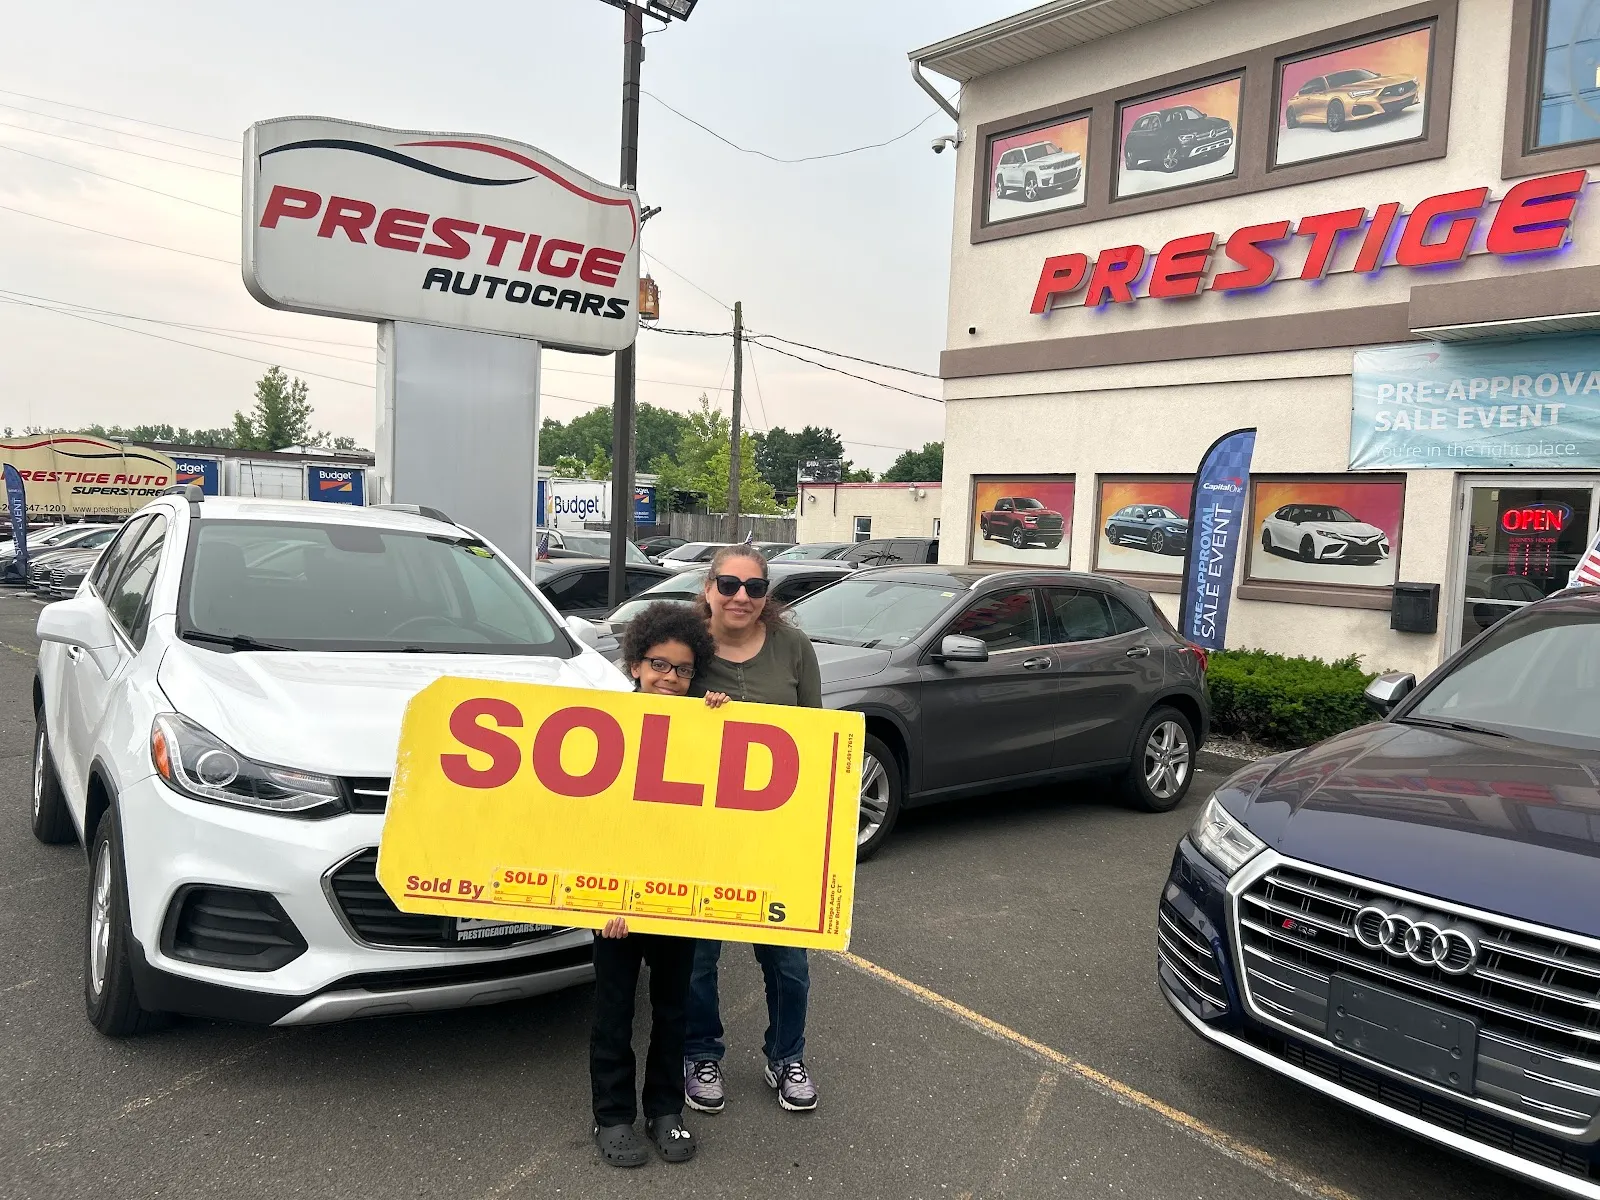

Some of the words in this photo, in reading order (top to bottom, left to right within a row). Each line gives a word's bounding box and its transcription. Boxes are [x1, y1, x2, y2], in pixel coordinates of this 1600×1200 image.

[259, 184, 626, 288] PRESTIGE
[1029, 169, 1590, 314] PRESTIGE
[422, 267, 630, 319] AUTOCARS
[1377, 370, 1600, 405] PRE-APPROVA
[1375, 408, 1447, 432] SALE
[1458, 403, 1566, 428] EVENT
[1375, 444, 1421, 457] You're
[1427, 444, 1441, 457] in
[1447, 442, 1474, 457] the
[1480, 440, 1520, 459] right
[1527, 440, 1580, 458] place.
[113, 474, 168, 486] AUTO
[319, 471, 352, 482] Budget
[554, 495, 599, 519] Budget
[1502, 509, 1563, 530] OPEN
[1208, 503, 1232, 577] EVENT
[1192, 502, 1216, 636] PRE-APPROVAL
[1201, 585, 1220, 640] SALE
[440, 697, 800, 811] SOLD
[406, 875, 452, 893] Sold
[458, 879, 485, 900] By
[504, 870, 548, 886] SOLD
[575, 875, 619, 891] SOLD
[645, 881, 688, 897] SOLD
[837, 884, 843, 893] CT
[713, 886, 757, 902] SOLD
